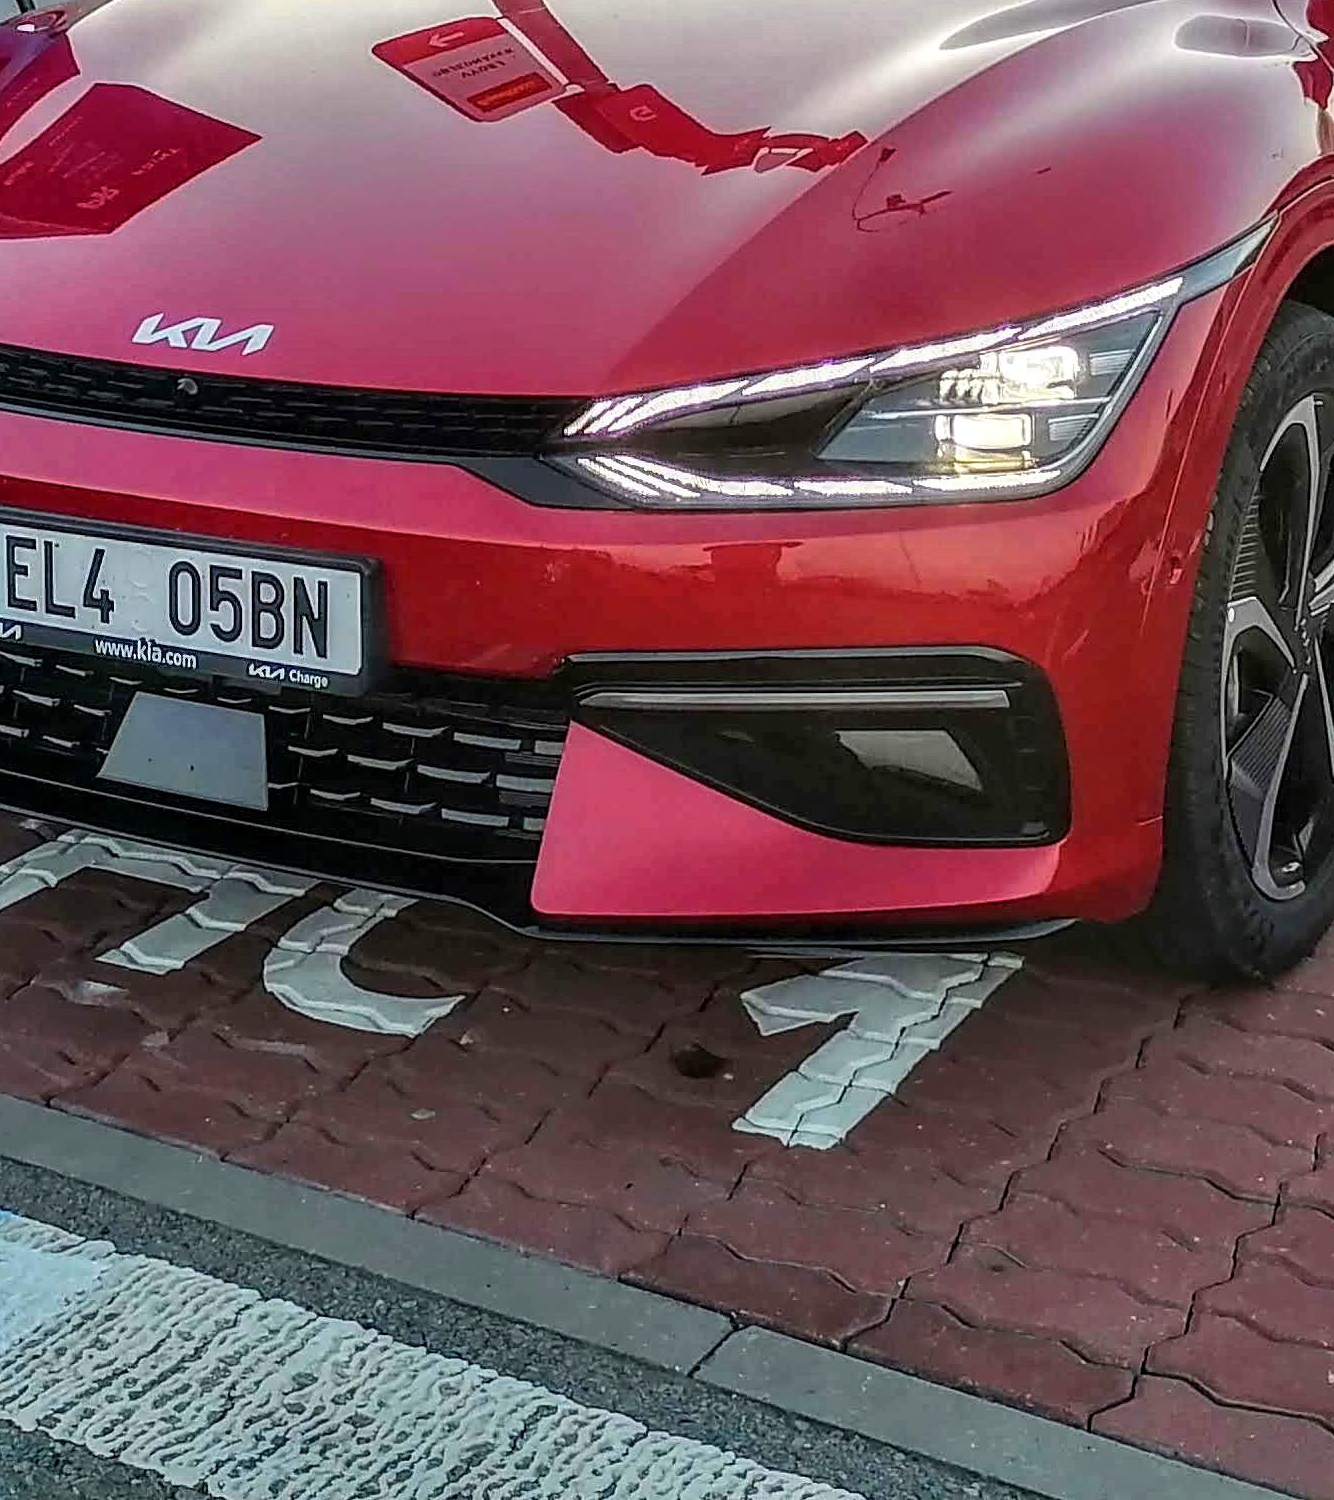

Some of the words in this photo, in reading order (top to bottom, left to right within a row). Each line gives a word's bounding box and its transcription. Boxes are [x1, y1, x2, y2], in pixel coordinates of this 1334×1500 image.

[131, 312, 275, 357] KIA
[5, 533, 115, 625] EL4
[167, 559, 329, 660] 05BN
[94, 638, 198, 670] www.kia.com
[288, 668, 330, 689] Charge
